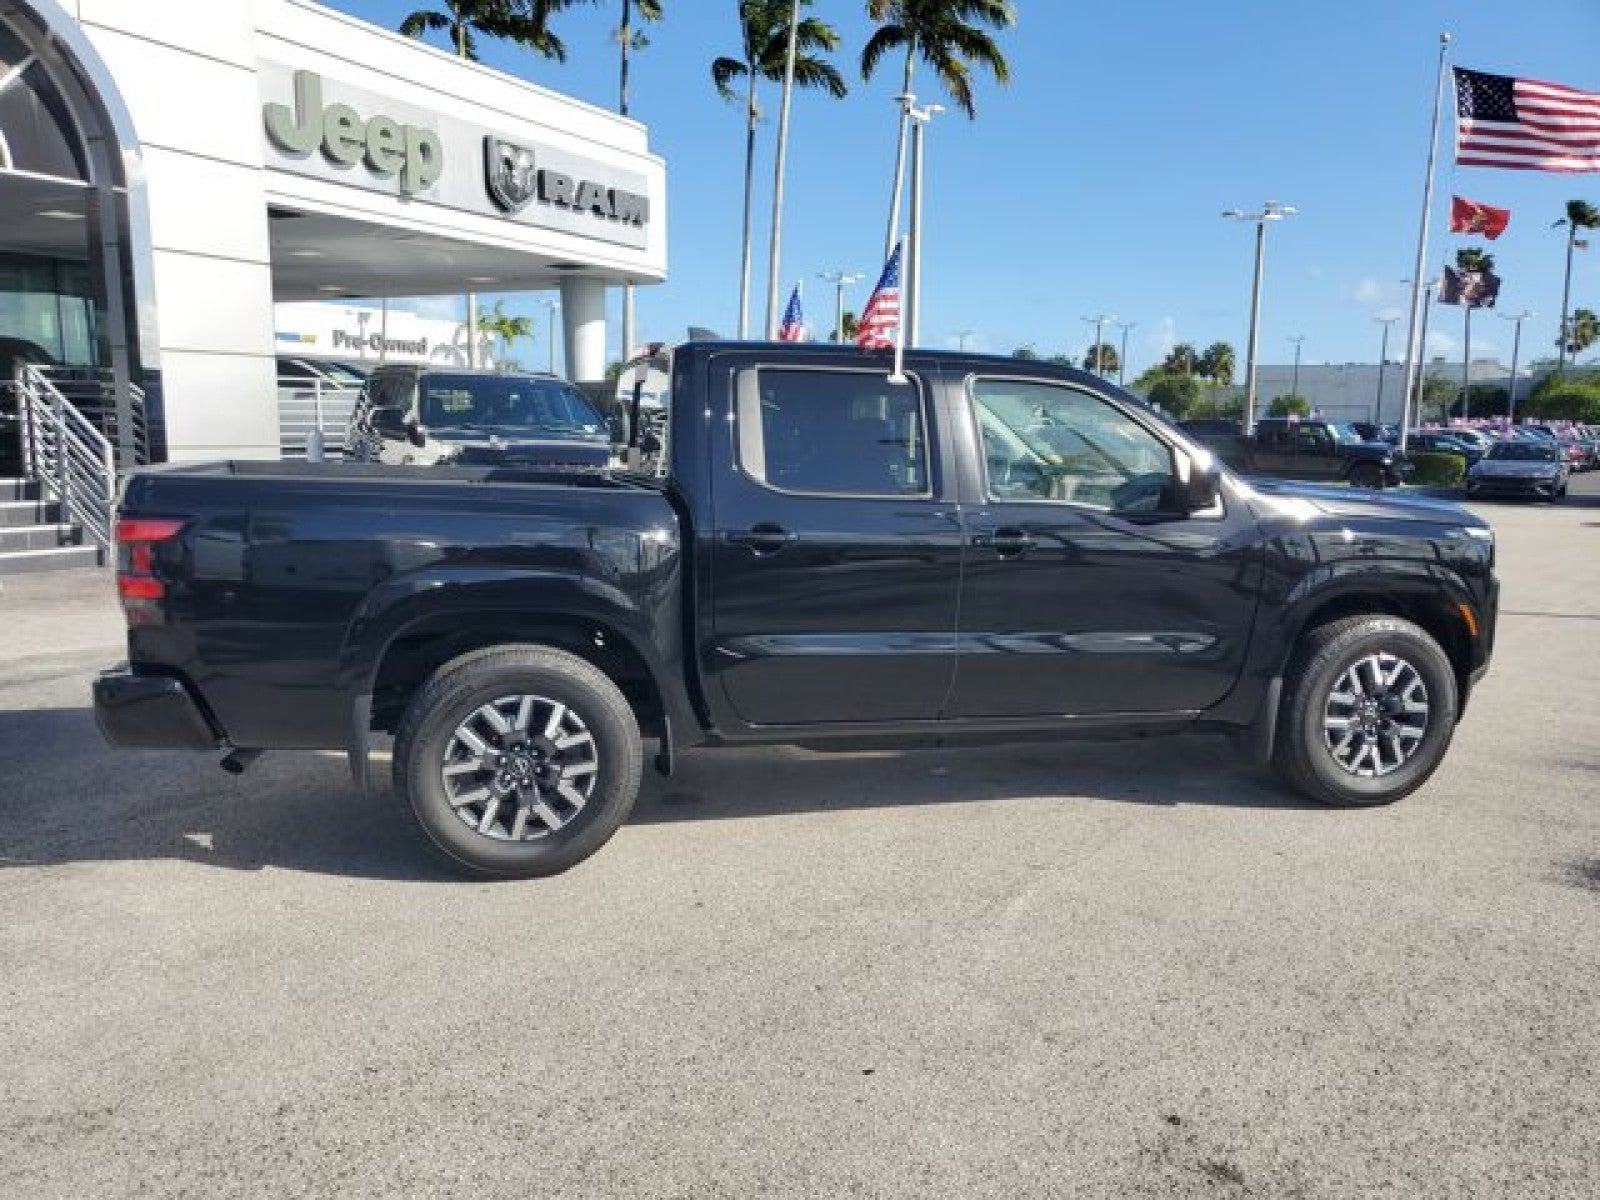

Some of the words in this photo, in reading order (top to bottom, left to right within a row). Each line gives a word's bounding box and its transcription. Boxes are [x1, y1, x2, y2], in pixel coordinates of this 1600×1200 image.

[263, 69, 443, 200] Jeep
[537, 169, 649, 226] RAM
[332, 329, 428, 355] Pre-Owned
